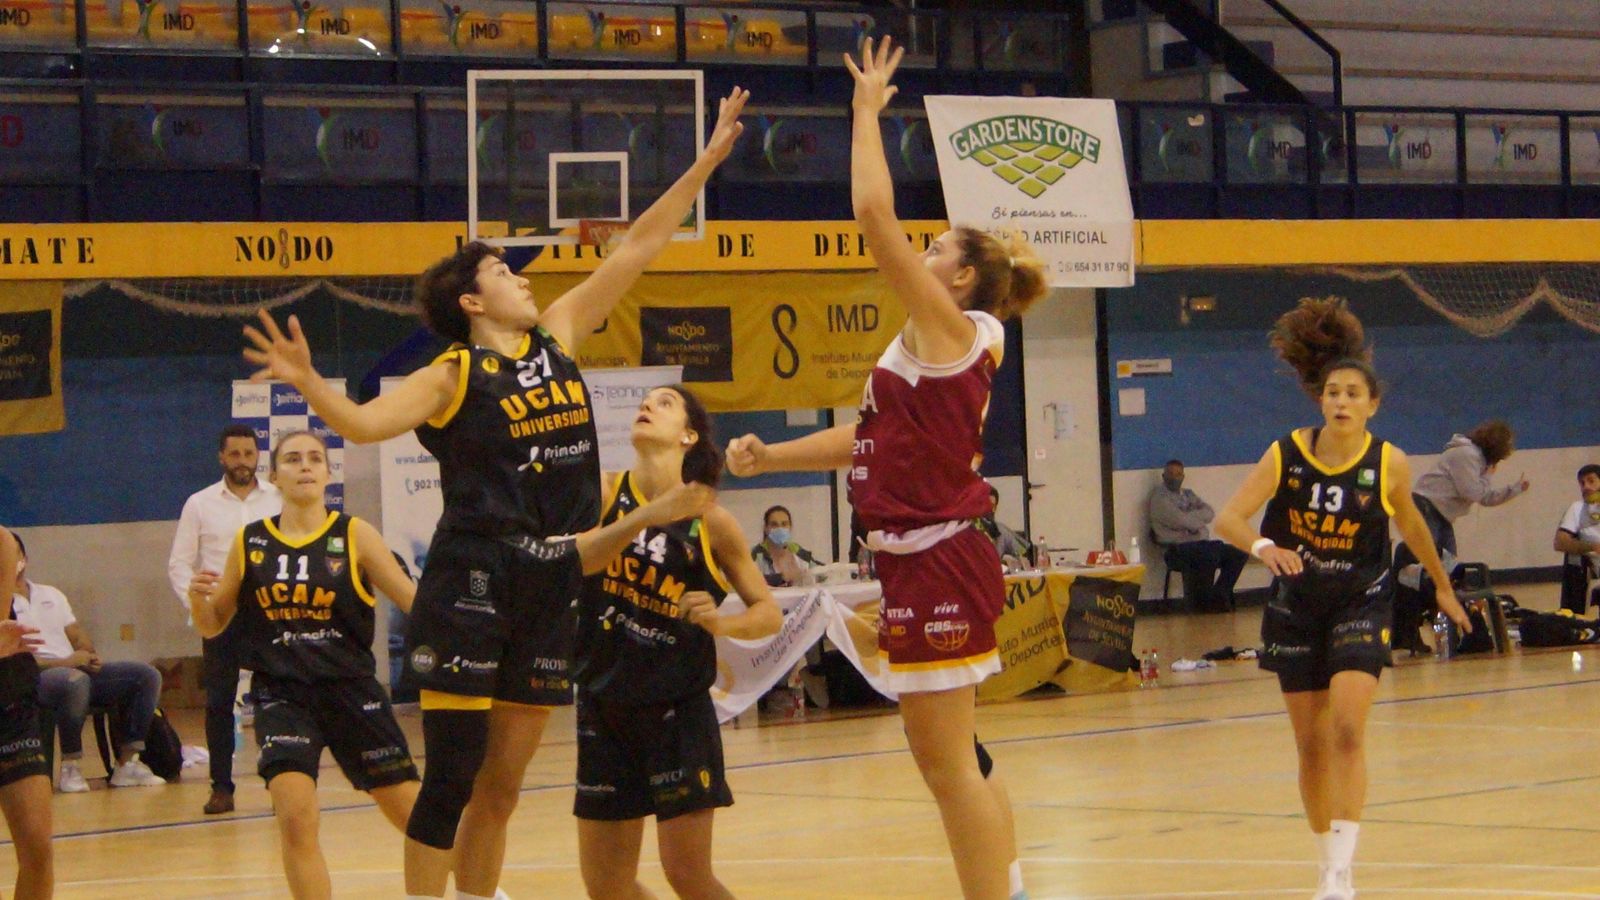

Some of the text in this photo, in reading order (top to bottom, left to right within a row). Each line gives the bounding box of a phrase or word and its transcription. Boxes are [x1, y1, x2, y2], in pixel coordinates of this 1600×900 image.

[163, 14, 194, 30] IMD
[320, 18, 350, 35] IMD
[470, 23, 499, 39] IMD
[614, 29, 641, 45] IMD
[747, 33, 773, 48] IMD
[951, 118, 1099, 162] GARDENSTORE
[1407, 142, 1432, 160] IMD
[1513, 143, 1538, 160] IMD
[717, 233, 755, 257] DE
[1034, 230, 1108, 244] ARTIFICIAL
[1074, 262, 1090, 272] 654
[1091, 262, 1102, 272] 31
[1104, 262, 1115, 272] 87
[827, 303, 879, 333] IMD
[499, 378, 586, 421] UCAM
[414, 479, 432, 491] 902
[1308, 482, 1344, 513] 13
[1288, 507, 1361, 538] UCAM
[275, 553, 311, 580] 11
[255, 582, 337, 609] UCAM
[933, 601, 960, 615] vive
[924, 619, 952, 633] CBS
